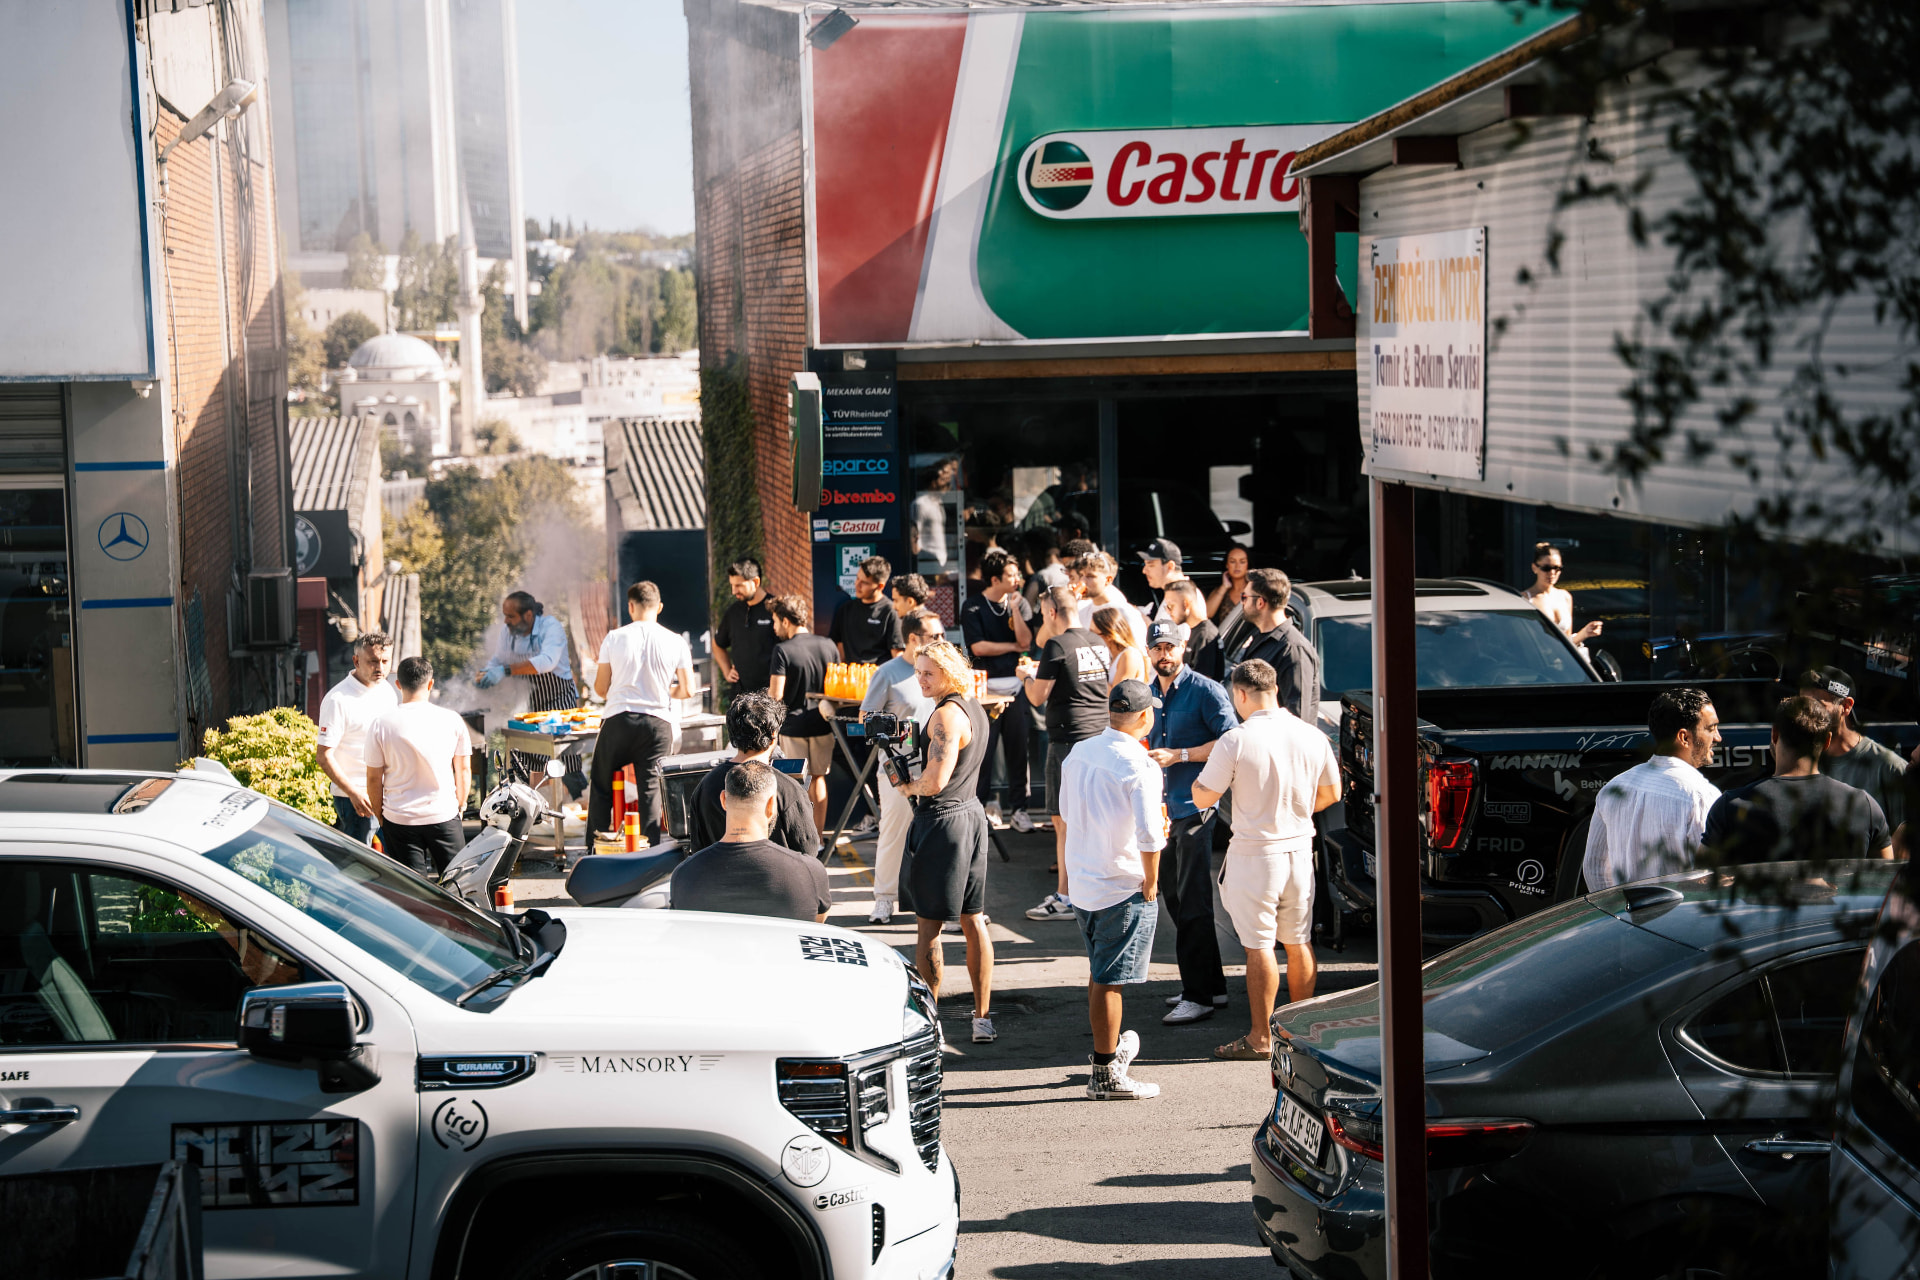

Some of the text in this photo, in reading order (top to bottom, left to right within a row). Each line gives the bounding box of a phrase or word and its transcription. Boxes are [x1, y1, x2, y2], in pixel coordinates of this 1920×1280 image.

[1439, 256, 1481, 327] MOTOR
[1374, 344, 1400, 387] Tamir
[1403, 346, 1410, 387] &
[1447, 344, 1480, 390] Servisi
[822, 458, 889, 476] sparco
[834, 488, 895, 504] brembo
[842, 521, 880, 533] Castrol
[1509, 881, 1545, 895] Privatus
[456, 1063, 504, 1071] DURAMAX
[0, 1071, 30, 1081] SAFE
[444, 1106, 479, 1136] trd
[1279, 1096, 1288, 1127] 34
[1288, 1104, 1305, 1139] KJF
[1304, 1118, 1320, 1154] 994
